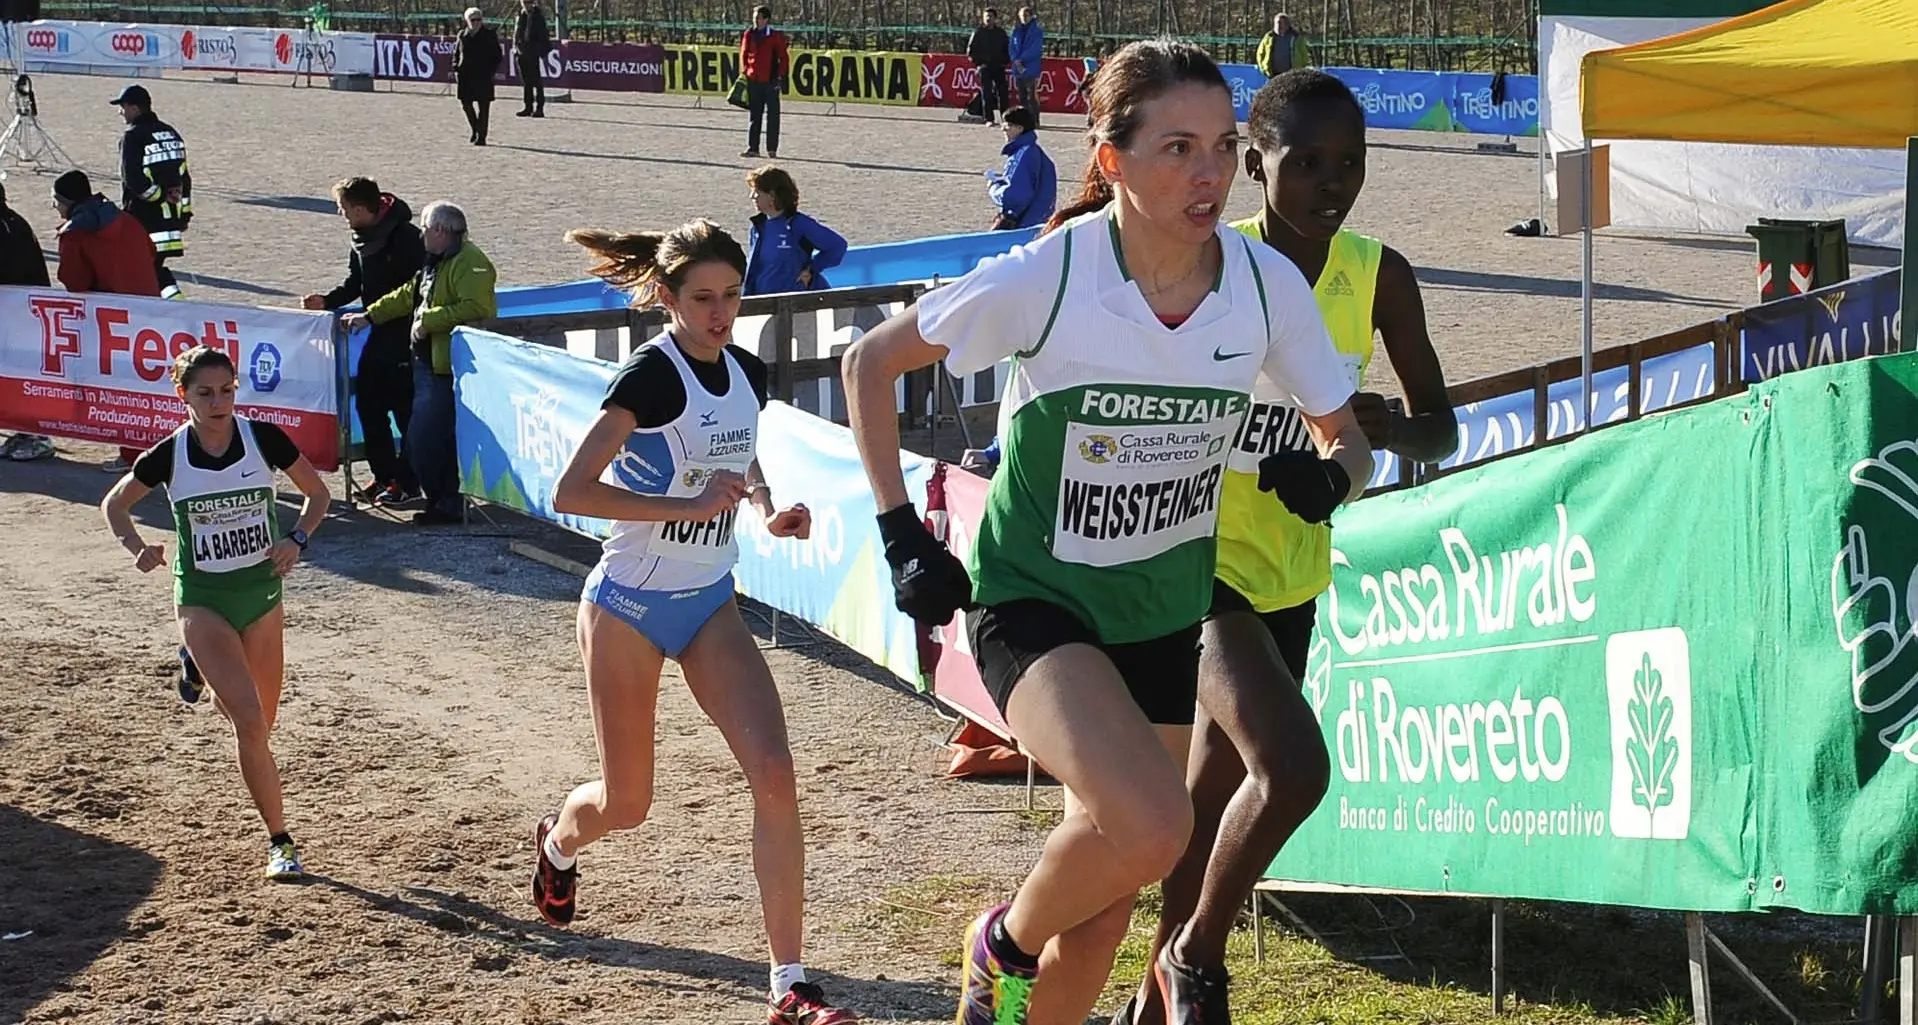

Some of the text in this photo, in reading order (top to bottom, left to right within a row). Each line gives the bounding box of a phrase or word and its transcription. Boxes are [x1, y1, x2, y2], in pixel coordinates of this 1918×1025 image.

[27, 30, 56, 52] coop
[112, 34, 144, 56] coop
[375, 40, 435, 79] ITAS
[565, 59, 663, 76] ASSICURAZIONI
[96, 306, 240, 382] Festi
[23, 381, 83, 401] Serramenti
[85, 391, 96, 402] in
[99, 390, 149, 409] Alluminio
[88, 406, 301, 430] Produzione Porte Continue
[706, 442, 751, 457] AZZURRE
[710, 428, 751, 446] FIAMME
[1120, 431, 1211, 449] Cassa Rurale
[1117, 449, 1199, 464] di Rovereto
[187, 491, 262, 512] FORESTALE
[1062, 463, 1222, 541] WEISSTEINER
[194, 521, 270, 561] LA BARBERA
[1329, 503, 1596, 656] Cassa Rurale
[609, 588, 648, 614] FIAMME
[1336, 677, 1571, 784] di Rovereto
[1339, 794, 1605, 847] Banca di Credito Cooperativo
